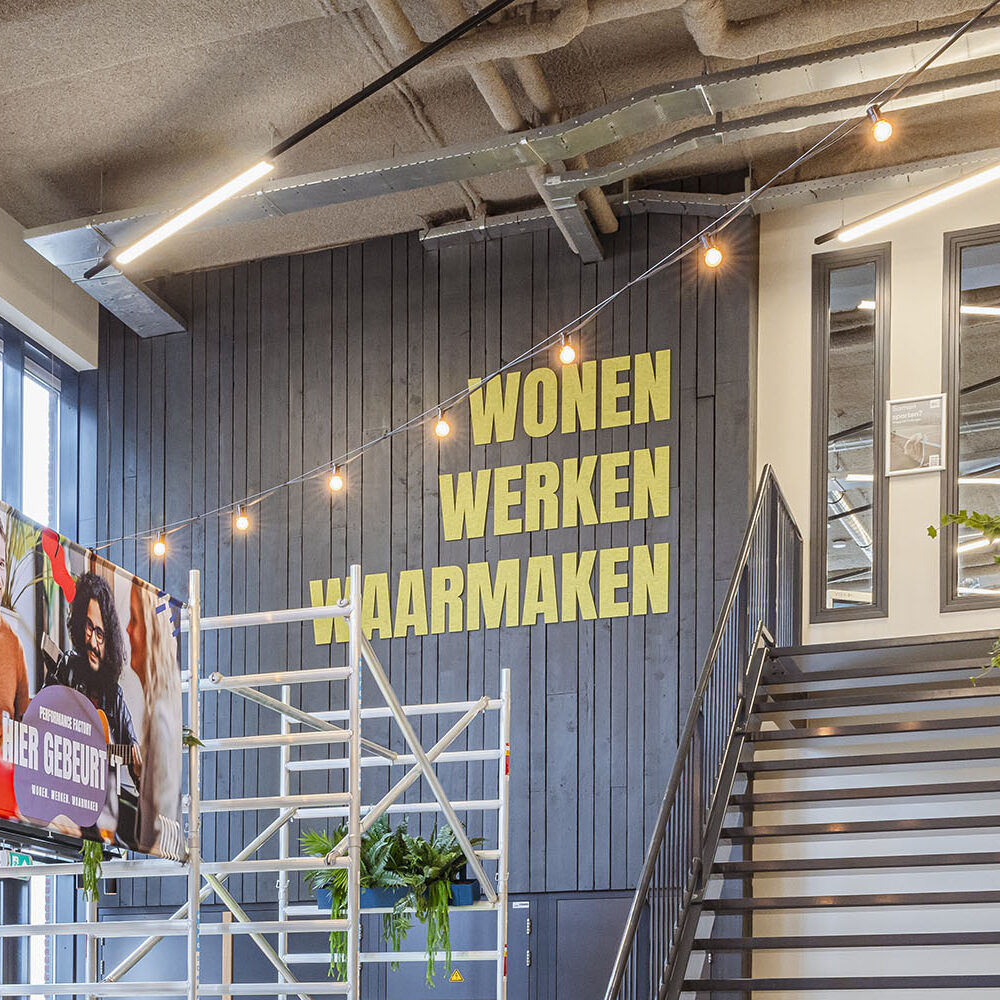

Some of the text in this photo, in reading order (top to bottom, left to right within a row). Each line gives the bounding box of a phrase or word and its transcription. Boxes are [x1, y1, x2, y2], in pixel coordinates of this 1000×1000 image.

[467, 349, 671, 446] WONEN
[438, 445, 670, 541] WERKEN
[309, 542, 670, 645] WAARMAKEN
[2, 711, 39, 771] HIER
[44, 731, 107, 791] GEBEURT
[40, 705, 92, 736] PERFORMANCE FACTORY
